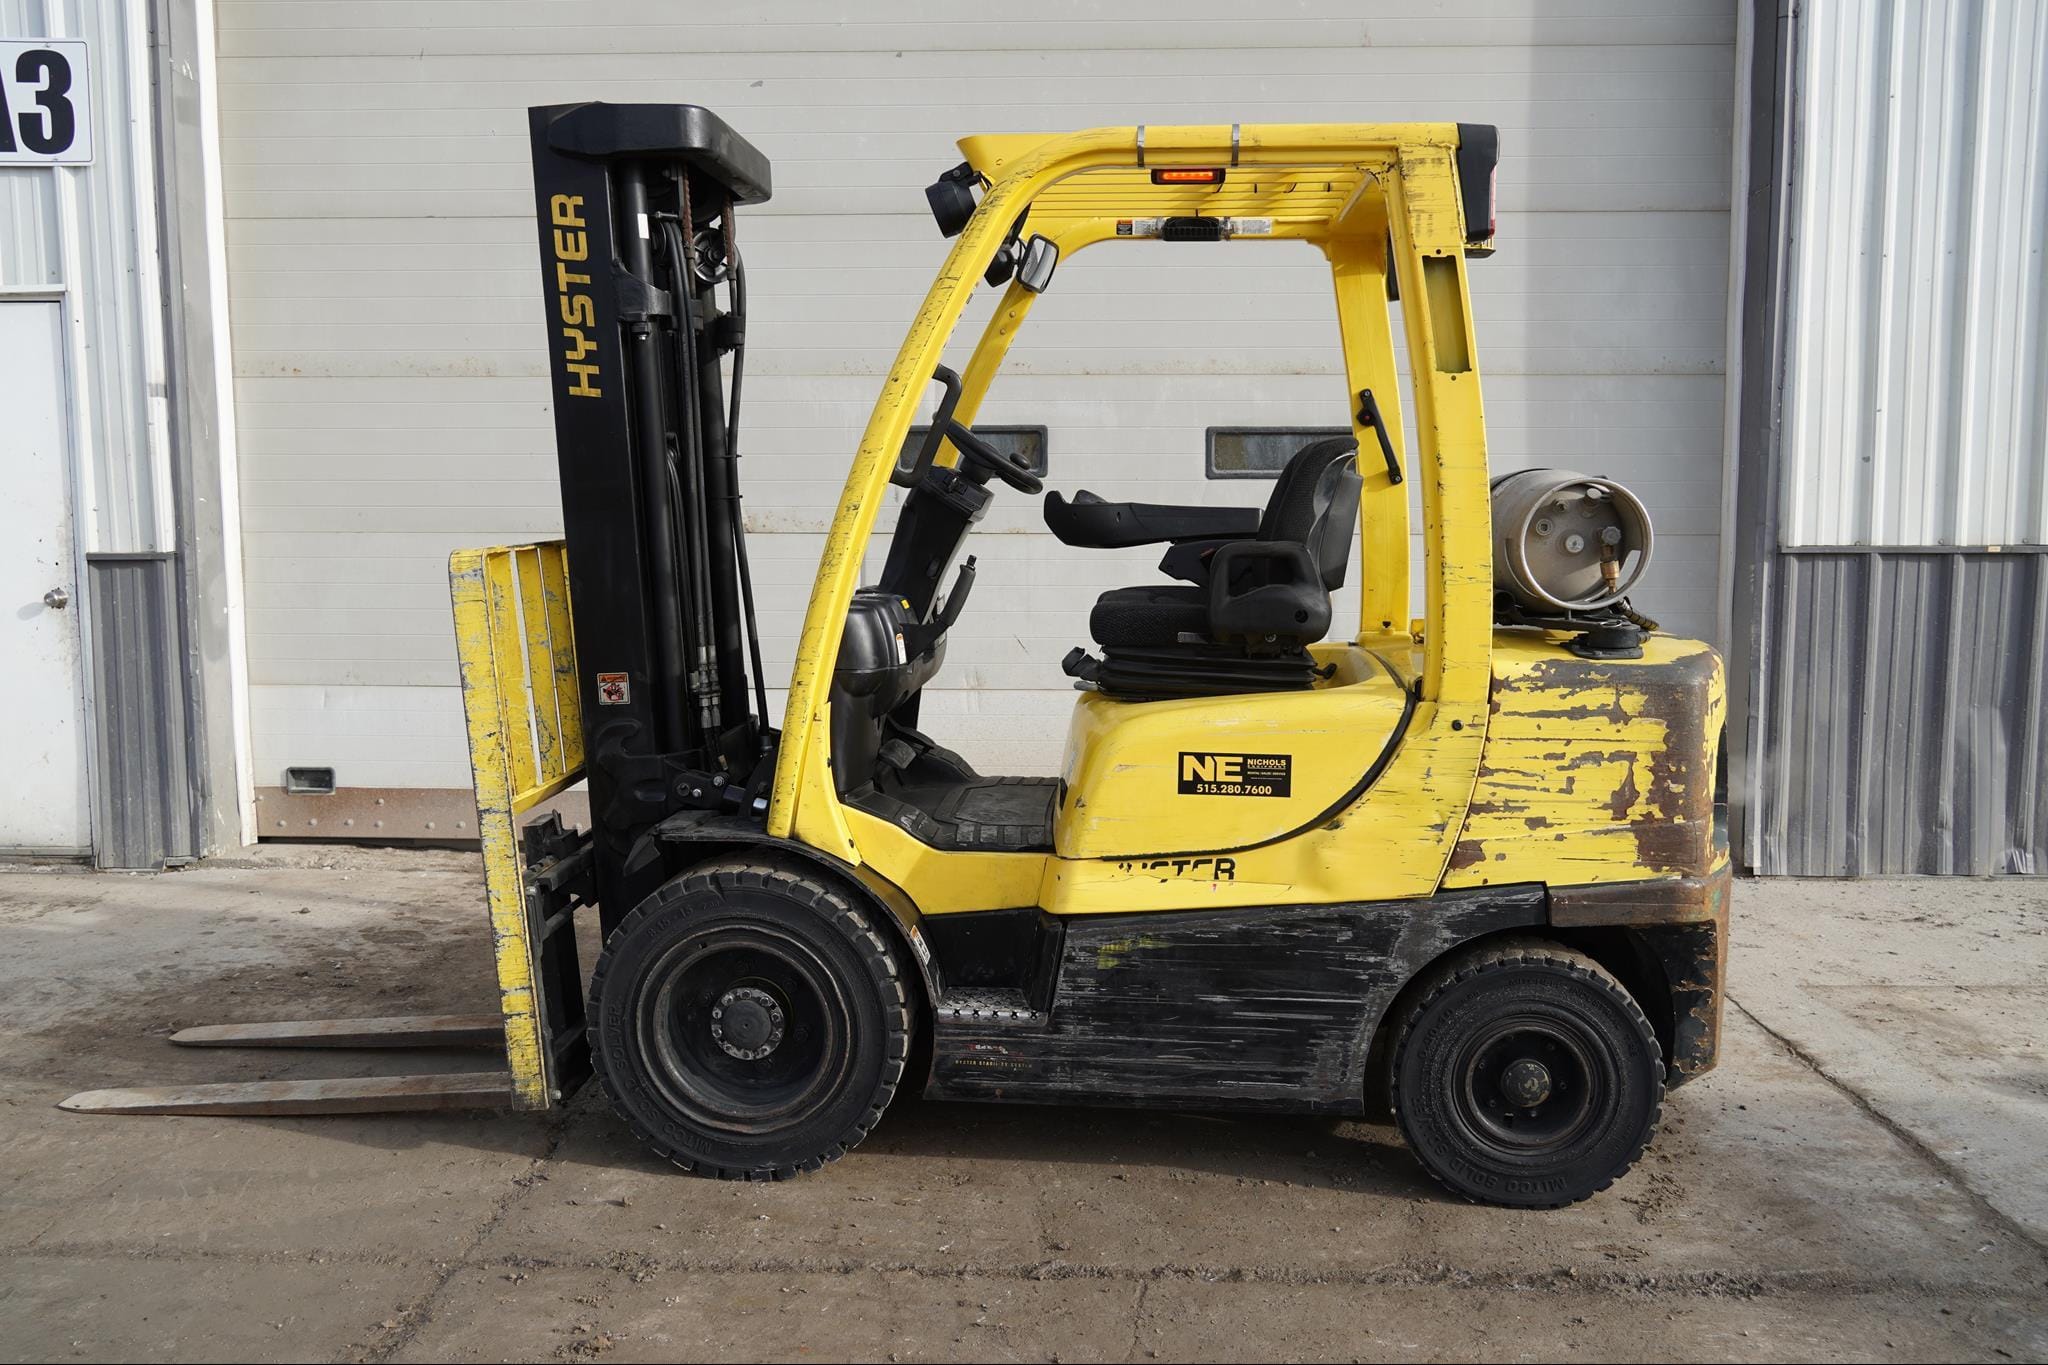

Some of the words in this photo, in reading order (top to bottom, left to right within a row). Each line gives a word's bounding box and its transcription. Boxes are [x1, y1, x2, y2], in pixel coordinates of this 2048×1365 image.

[551, 193, 602, 398] HYSTER
[1183, 755, 1243, 782] NE
[1247, 758, 1287, 766] NICHOLS
[1196, 784, 1272, 795] 515.280.7600
[607, 1006, 627, 1071] SOLVER
[1449, 1158, 1499, 1190] SOLID
[1505, 1175, 1569, 1195] MITCO
